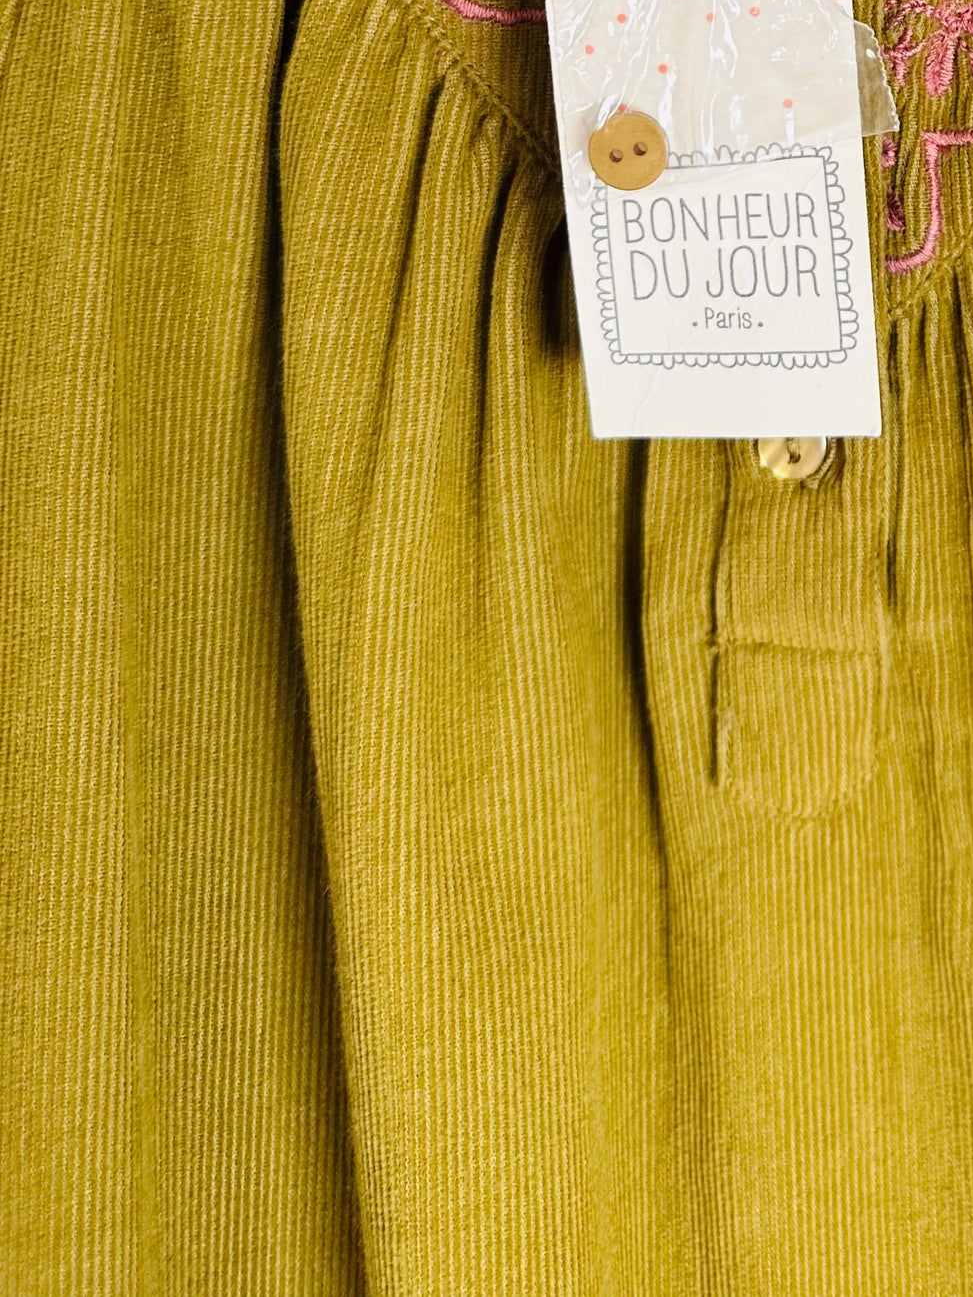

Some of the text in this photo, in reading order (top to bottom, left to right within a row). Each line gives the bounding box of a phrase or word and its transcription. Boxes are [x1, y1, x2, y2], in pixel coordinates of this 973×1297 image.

[622, 192, 818, 244] BONHEUR
[630, 245, 821, 300] DU JOUR
